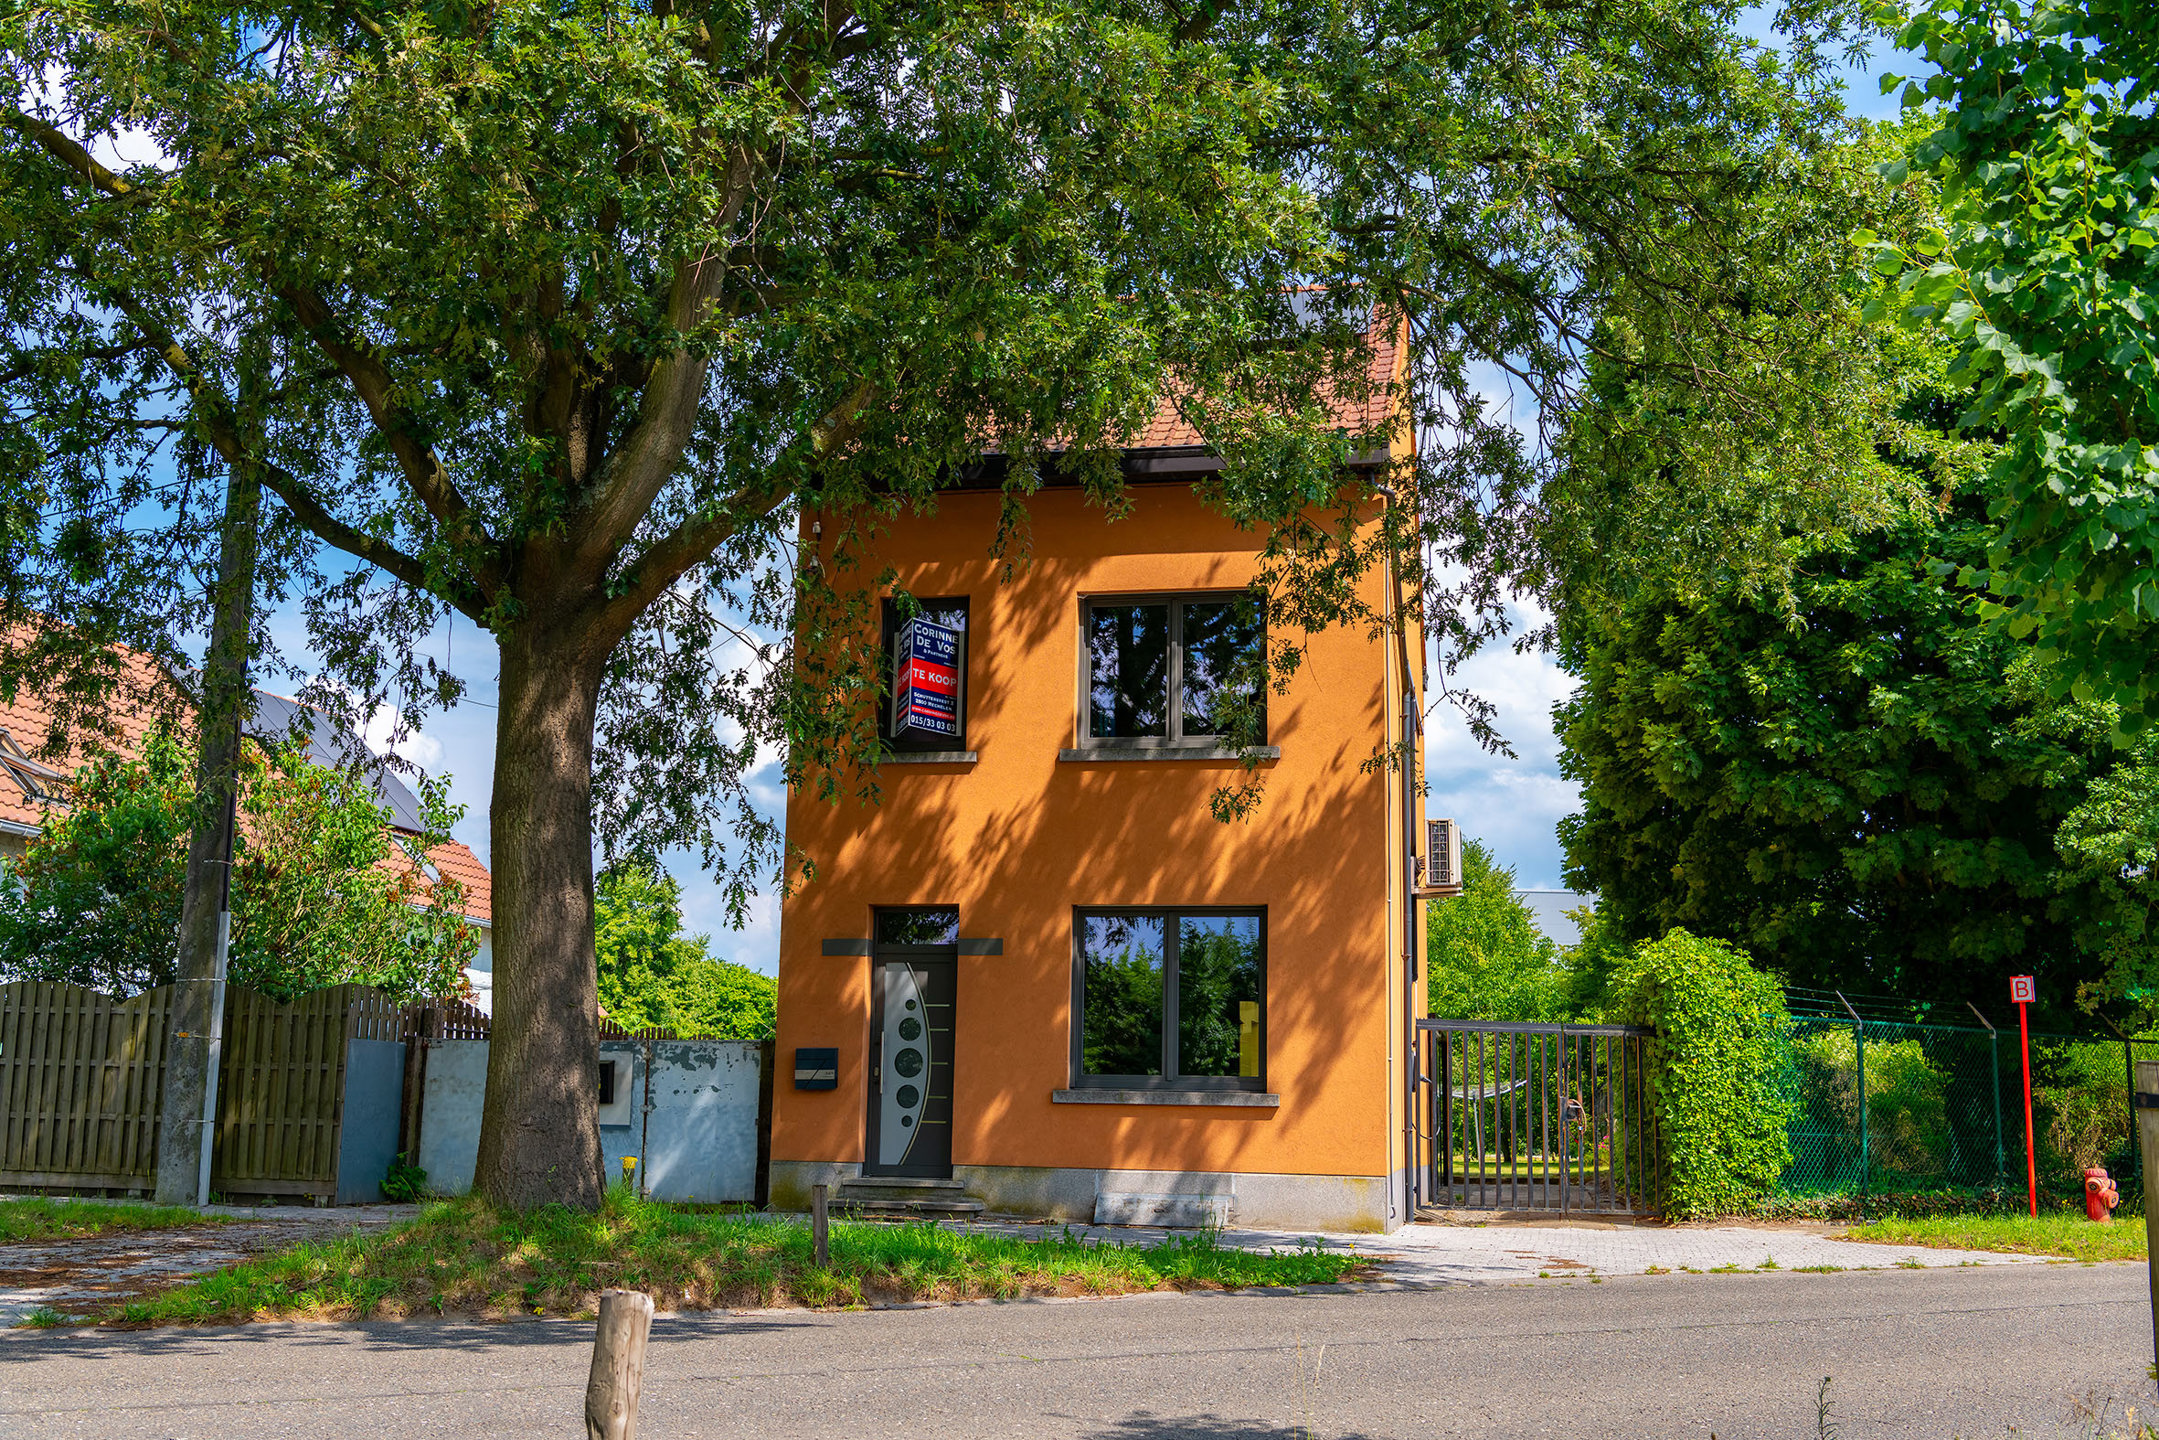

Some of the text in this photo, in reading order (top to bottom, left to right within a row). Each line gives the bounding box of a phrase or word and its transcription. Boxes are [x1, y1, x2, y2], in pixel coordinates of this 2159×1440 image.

[914, 623, 958, 644] CORINNE
[917, 635, 931, 648] DE
[937, 641, 956, 655] VOS
[913, 668, 957, 686] TE KOOP
[911, 715, 935, 727] 015/33
[936, 721, 945, 730] 03
[947, 723, 956, 732] 03
[2015, 981, 2029, 998] B
